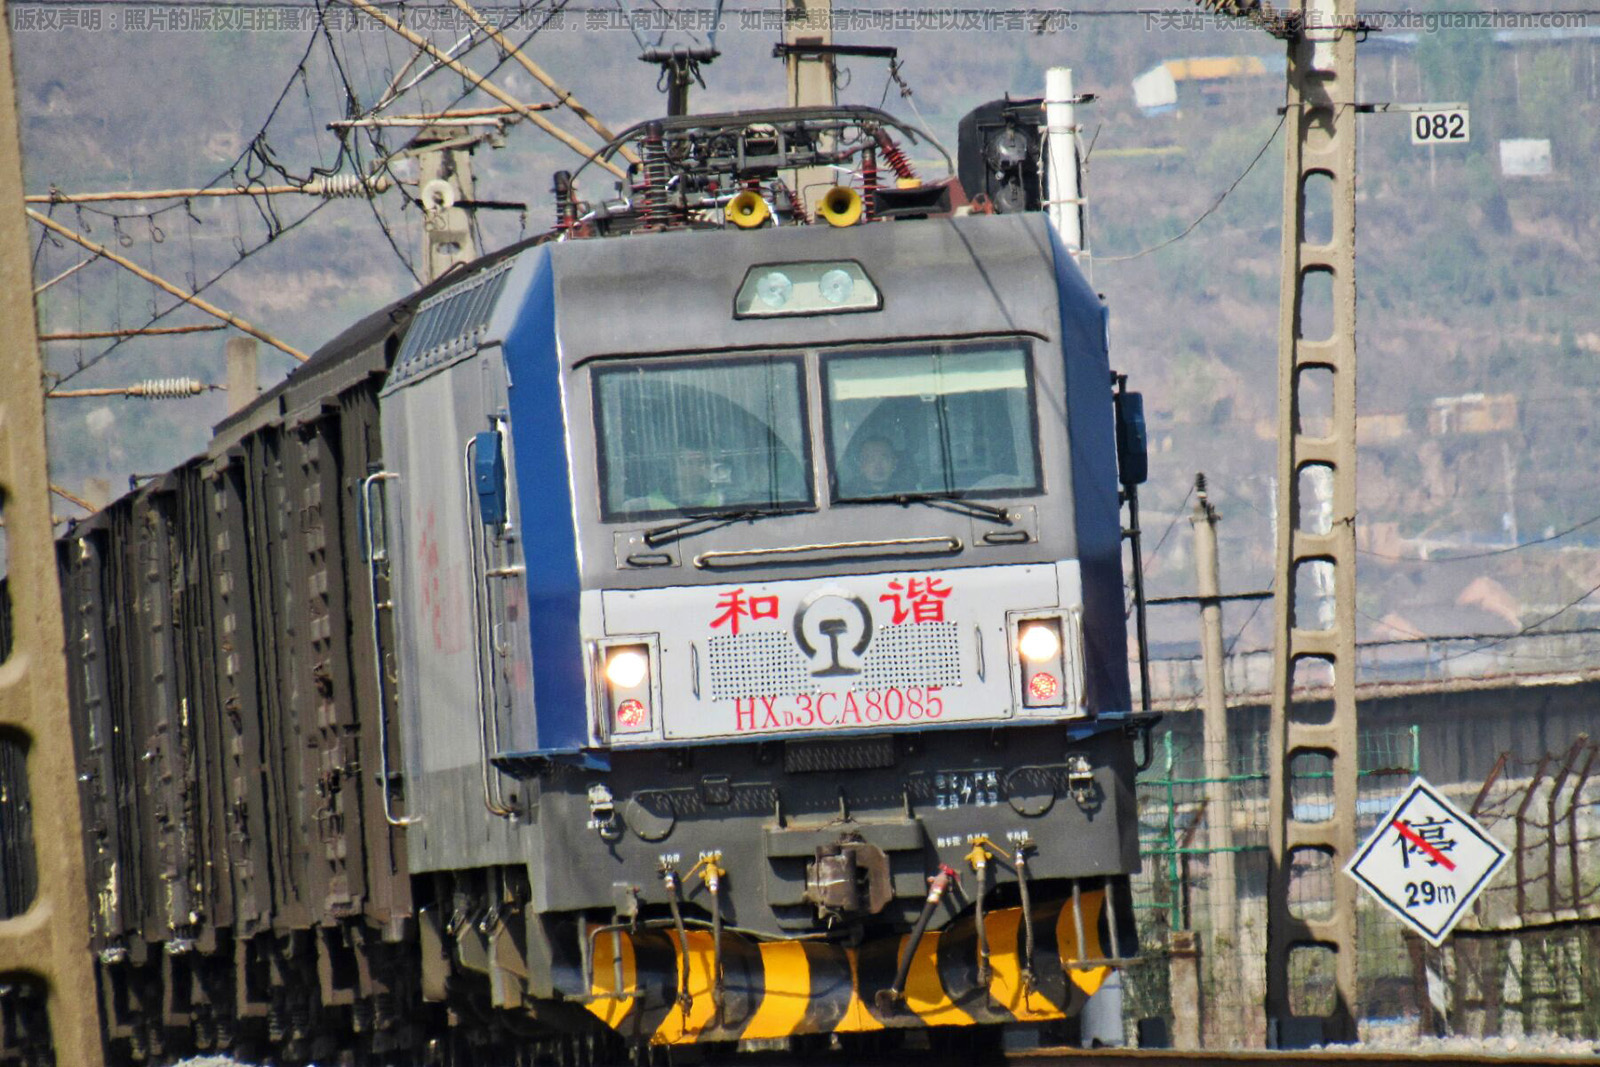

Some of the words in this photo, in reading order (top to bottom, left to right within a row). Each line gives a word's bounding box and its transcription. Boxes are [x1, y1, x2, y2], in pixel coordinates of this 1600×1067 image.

[1416, 113, 1465, 139] 082
[735, 686, 943, 731] HXD3CA8085
[1392, 816, 1458, 869] 停
[1404, 880, 1456, 909] 29m
